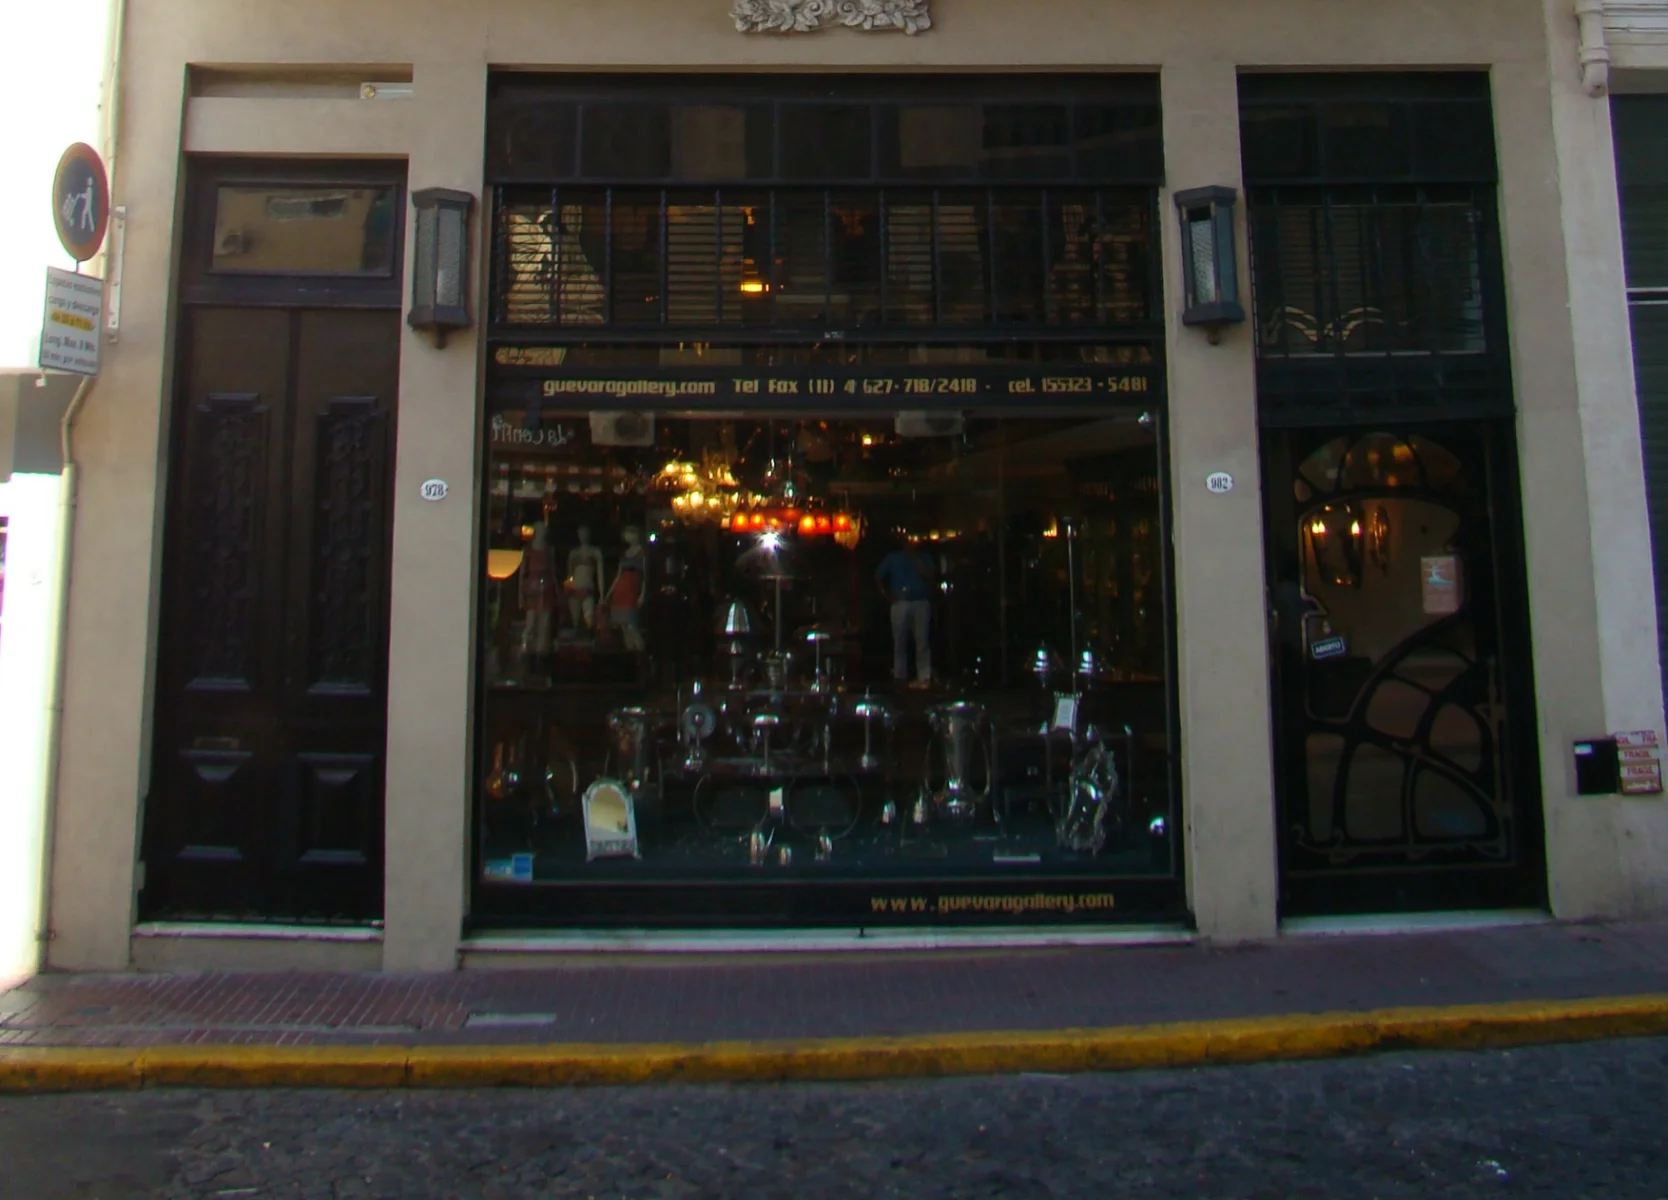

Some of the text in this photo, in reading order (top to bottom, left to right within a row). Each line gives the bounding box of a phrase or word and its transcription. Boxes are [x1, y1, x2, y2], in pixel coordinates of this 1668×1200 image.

[544, 378, 715, 397] guevaragallery.com
[733, 379, 759, 394] Tel
[768, 379, 798, 394] Fax
[425, 483, 445, 497] 978
[1211, 476, 1229, 490] 982
